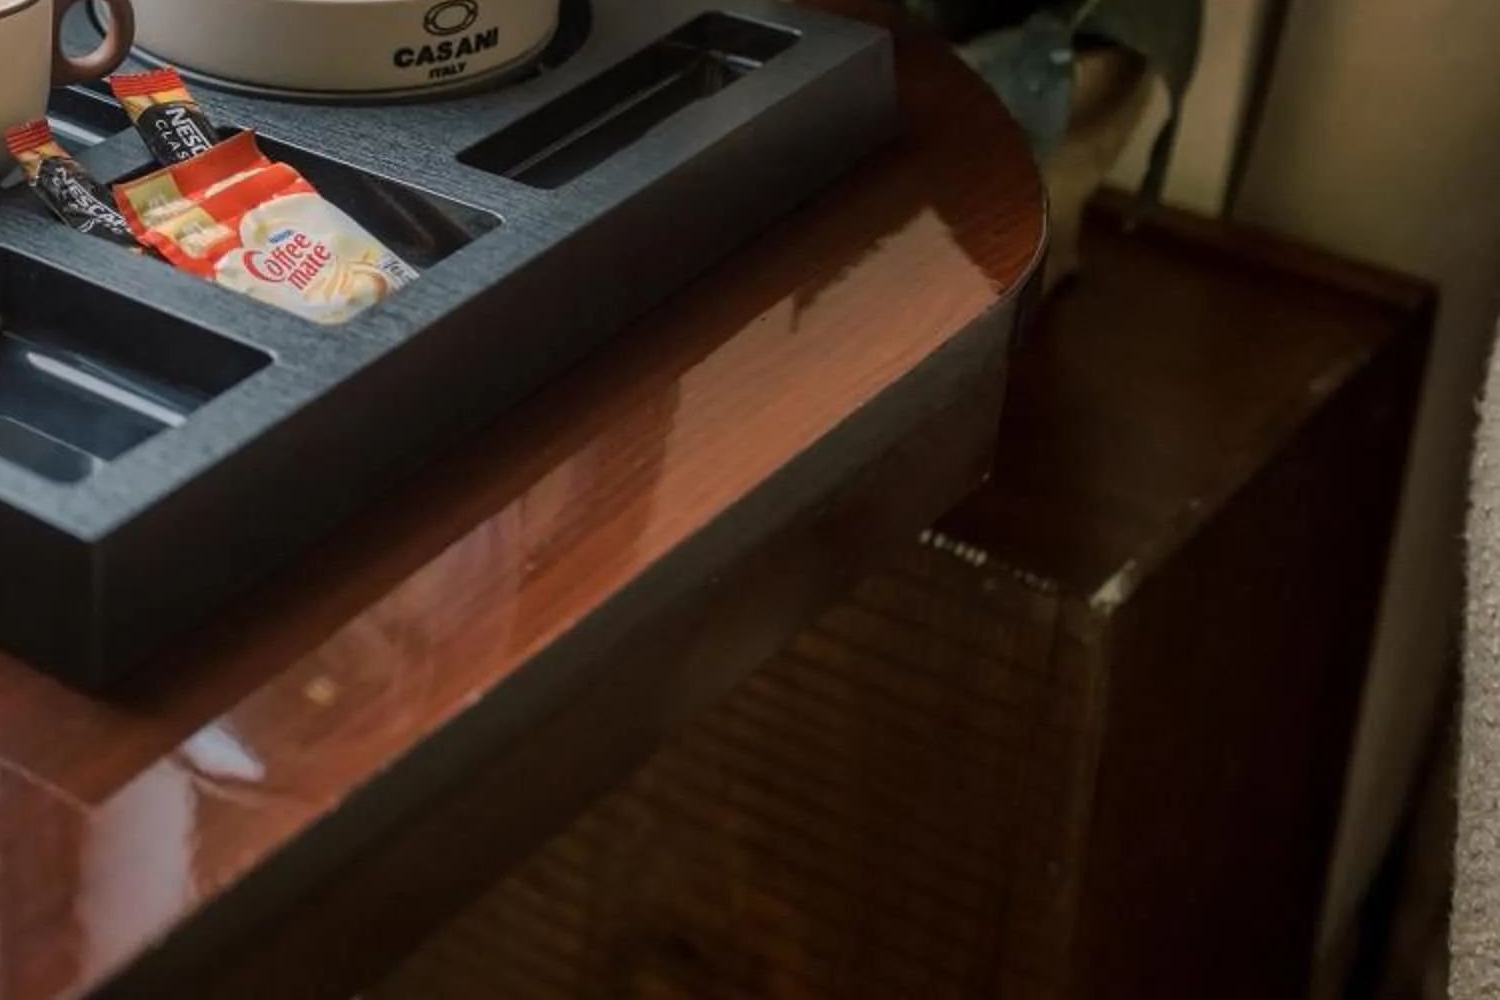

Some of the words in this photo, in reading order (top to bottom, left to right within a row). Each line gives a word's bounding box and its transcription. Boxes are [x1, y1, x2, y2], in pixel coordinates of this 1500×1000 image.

[393, 26, 499, 69] CASANI
[427, 62, 467, 80] ITALY
[242, 231, 312, 284] Coffee
[287, 240, 332, 291] mate
